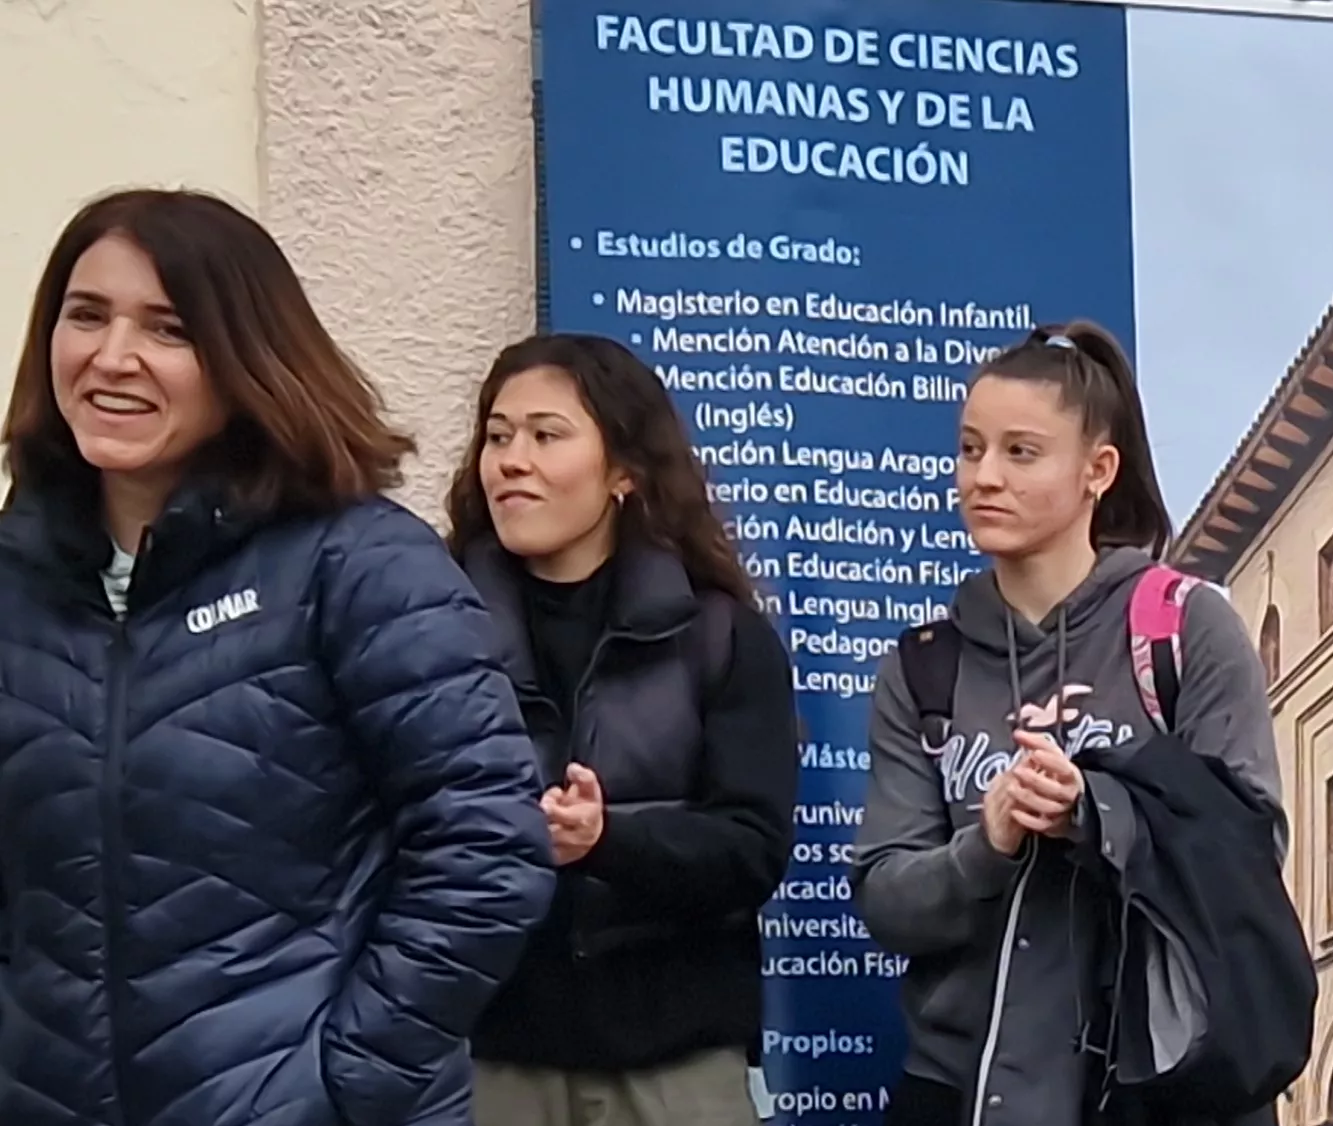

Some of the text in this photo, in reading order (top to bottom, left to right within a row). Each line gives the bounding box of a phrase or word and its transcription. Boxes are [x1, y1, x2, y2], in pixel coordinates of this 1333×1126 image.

[596, 14, 1080, 79] FACULTAD DE CIENCIAS
[648, 75, 1035, 133] HUMANAS Y DE LA
[720, 134, 970, 186] EDUCACIÓN
[597, 230, 862, 268] Estudios de Grado:
[616, 287, 1037, 331] Magisterio en Educación Infantil.
[652, 325, 771, 353] Mención
[777, 328, 890, 361] Atención
[894, 346, 909, 363] a
[916, 335, 938, 364] la
[654, 363, 773, 391] Mención
[778, 364, 907, 399] Educación
[695, 401, 796, 434] (Inglés)
[782, 438, 874, 475] Lengua
[879, 446, 961, 481] Arago
[773, 482, 808, 504] en
[814, 477, 940, 512] Educación
[784, 513, 895, 547] Audición
[899, 528, 916, 554] y
[786, 551, 914, 586] Educación
[186, 588, 261, 634] COLMAR
[788, 588, 880, 625] Lengua
[763, 1029, 875, 1060] Propios:
[842, 1091, 874, 1111] en
